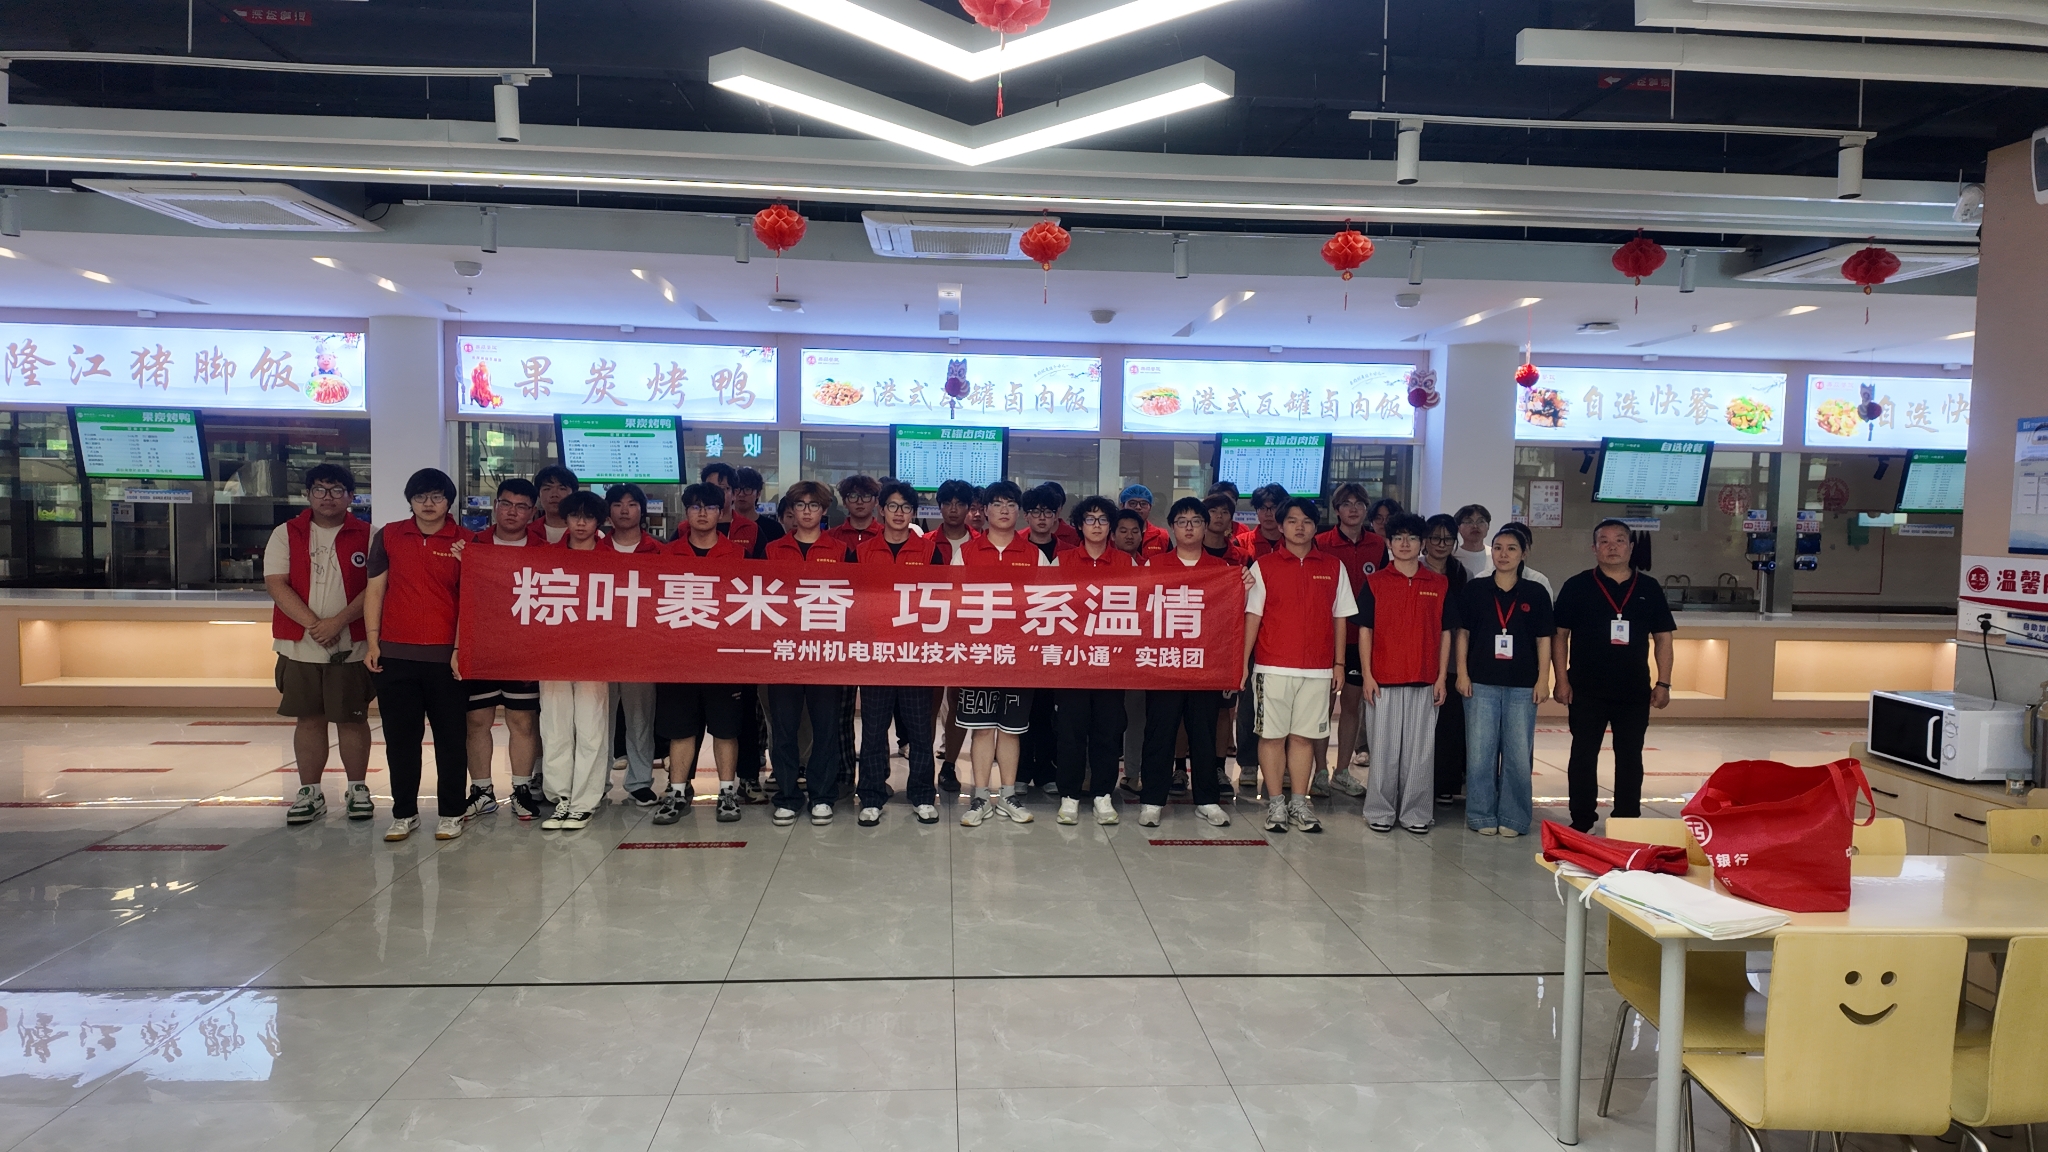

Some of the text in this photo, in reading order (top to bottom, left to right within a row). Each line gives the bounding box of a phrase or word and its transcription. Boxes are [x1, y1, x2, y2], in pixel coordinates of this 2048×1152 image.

[4, 338, 300, 395] 隆江猪脚饭
[514, 355, 756, 409] 果炭烤鸭
[1192, 386, 1404, 421] 港式瓦罐卤肉饭
[1583, 383, 1719, 425] 自选快餐
[142, 411, 191, 423] 果炭烤鸭
[624, 418, 672, 429] 果炭烤鸭
[940, 428, 997, 440] 瓦罐卤肉饭
[1264, 435, 1320, 446] 瓦罐卤肉饭
[1660, 441, 1704, 453] 自选快餐
[1996, 569, 2048, 595] 温馨
[511, 567, 1205, 639] 粽叶裹米香 巧手系温情
[2023, 622, 2048, 633] 自助加
